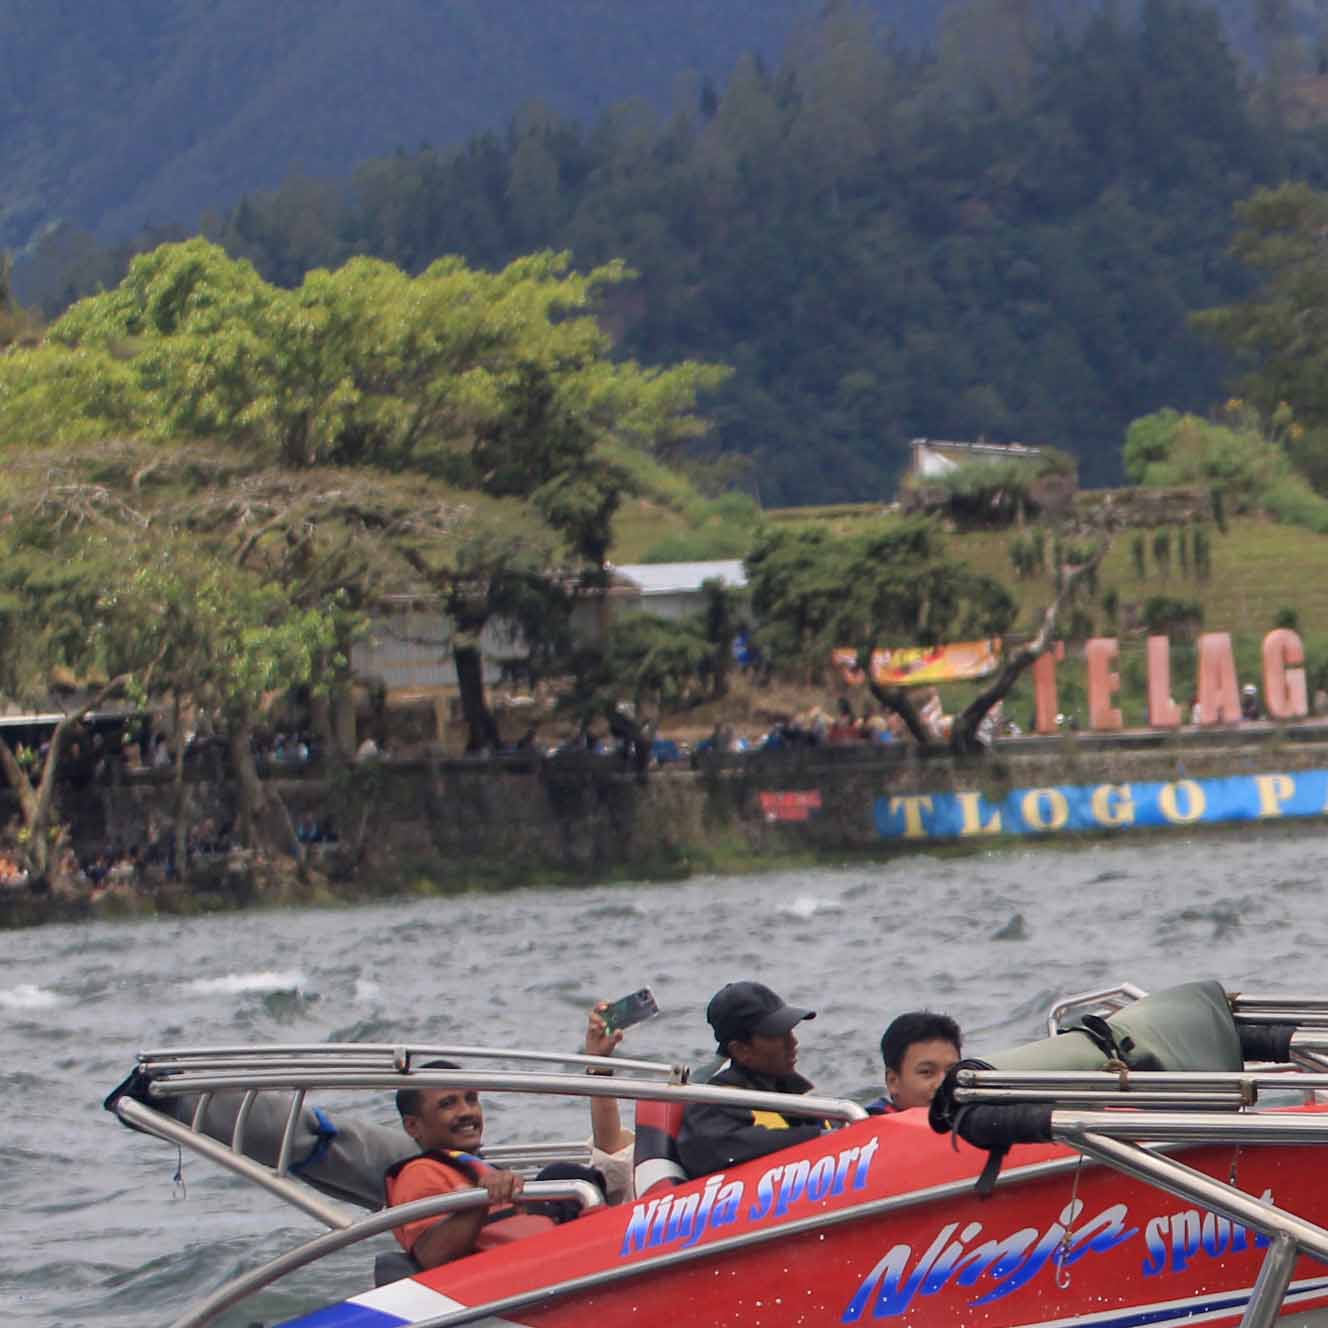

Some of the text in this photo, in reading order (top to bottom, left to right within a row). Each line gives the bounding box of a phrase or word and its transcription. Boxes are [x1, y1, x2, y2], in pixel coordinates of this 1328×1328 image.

[890, 779, 1206, 838] TLOGO
[620, 1174, 745, 1257] Ninja
[840, 1198, 1140, 1323] Ninja
